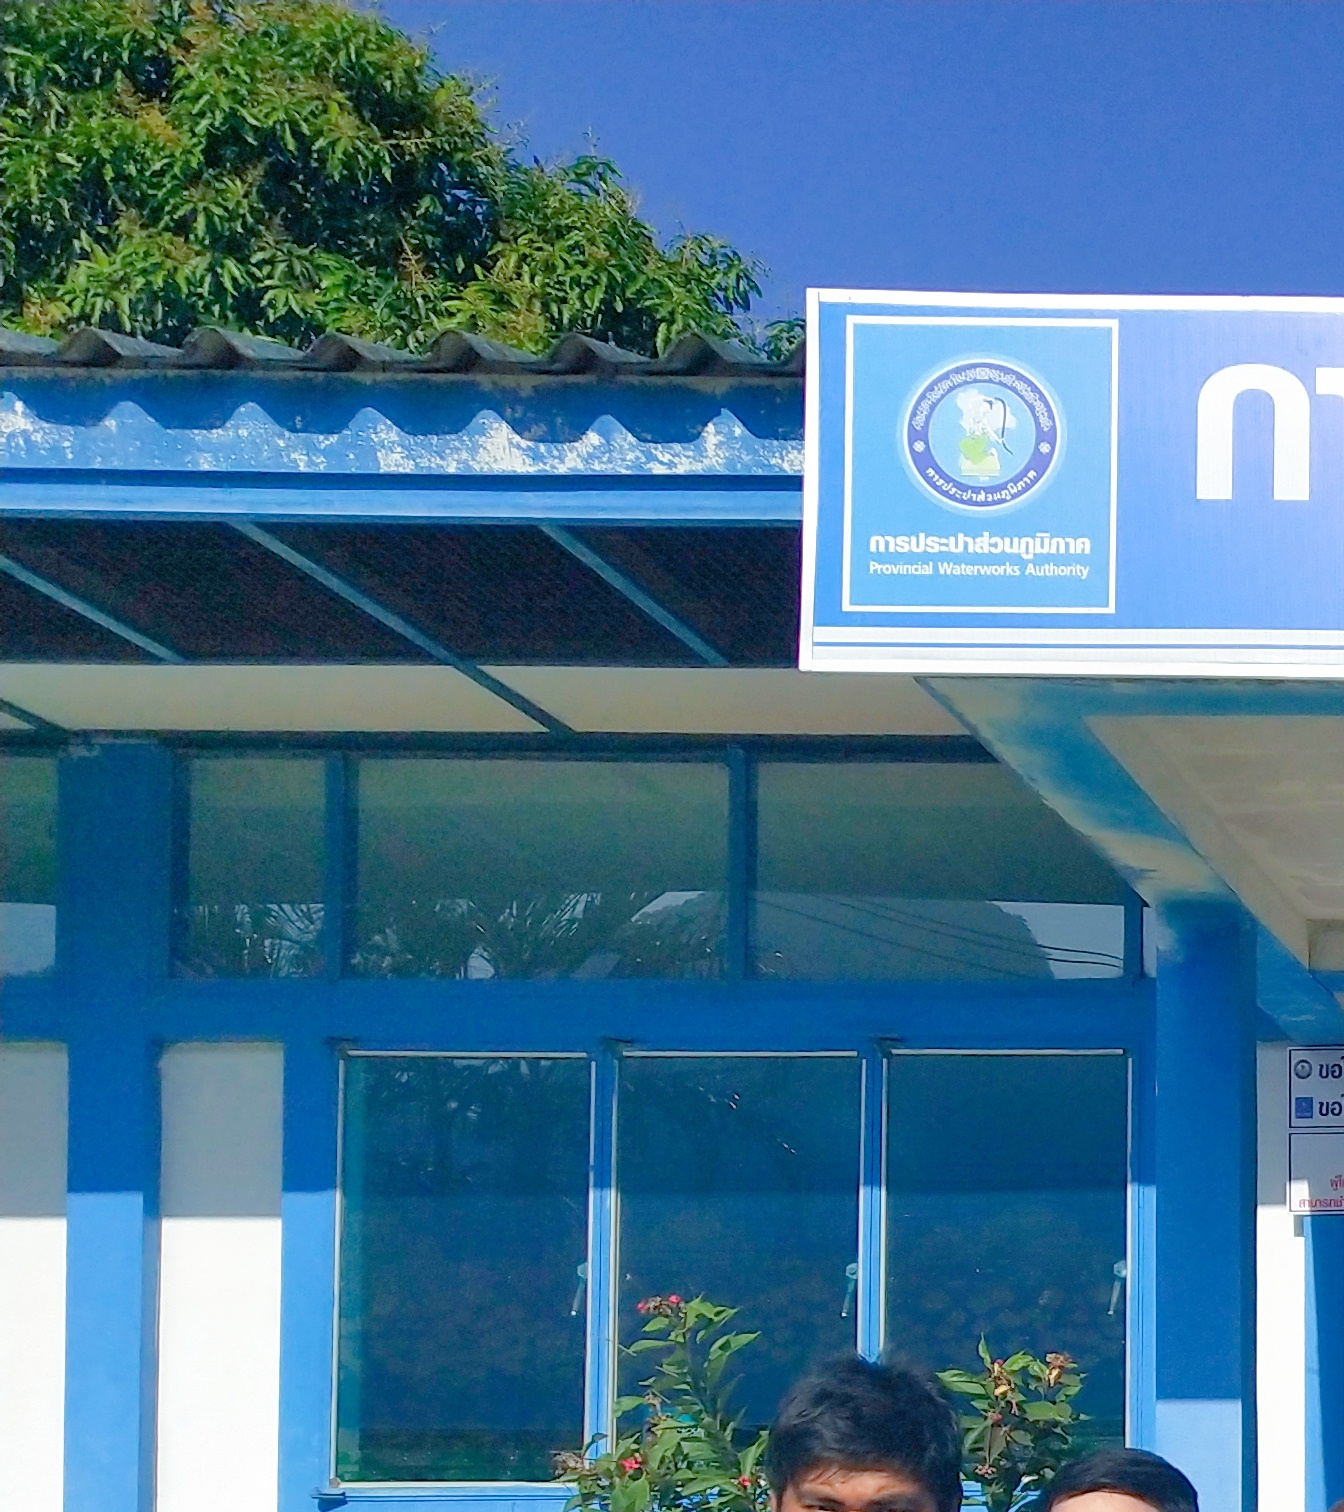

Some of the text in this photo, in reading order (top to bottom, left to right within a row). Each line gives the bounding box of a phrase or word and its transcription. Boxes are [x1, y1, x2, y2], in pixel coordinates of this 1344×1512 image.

[869, 532, 1091, 559] การประปาส่วนภูมิภาค
[869, 561, 1089, 579] Provincial Waterworks Authority
